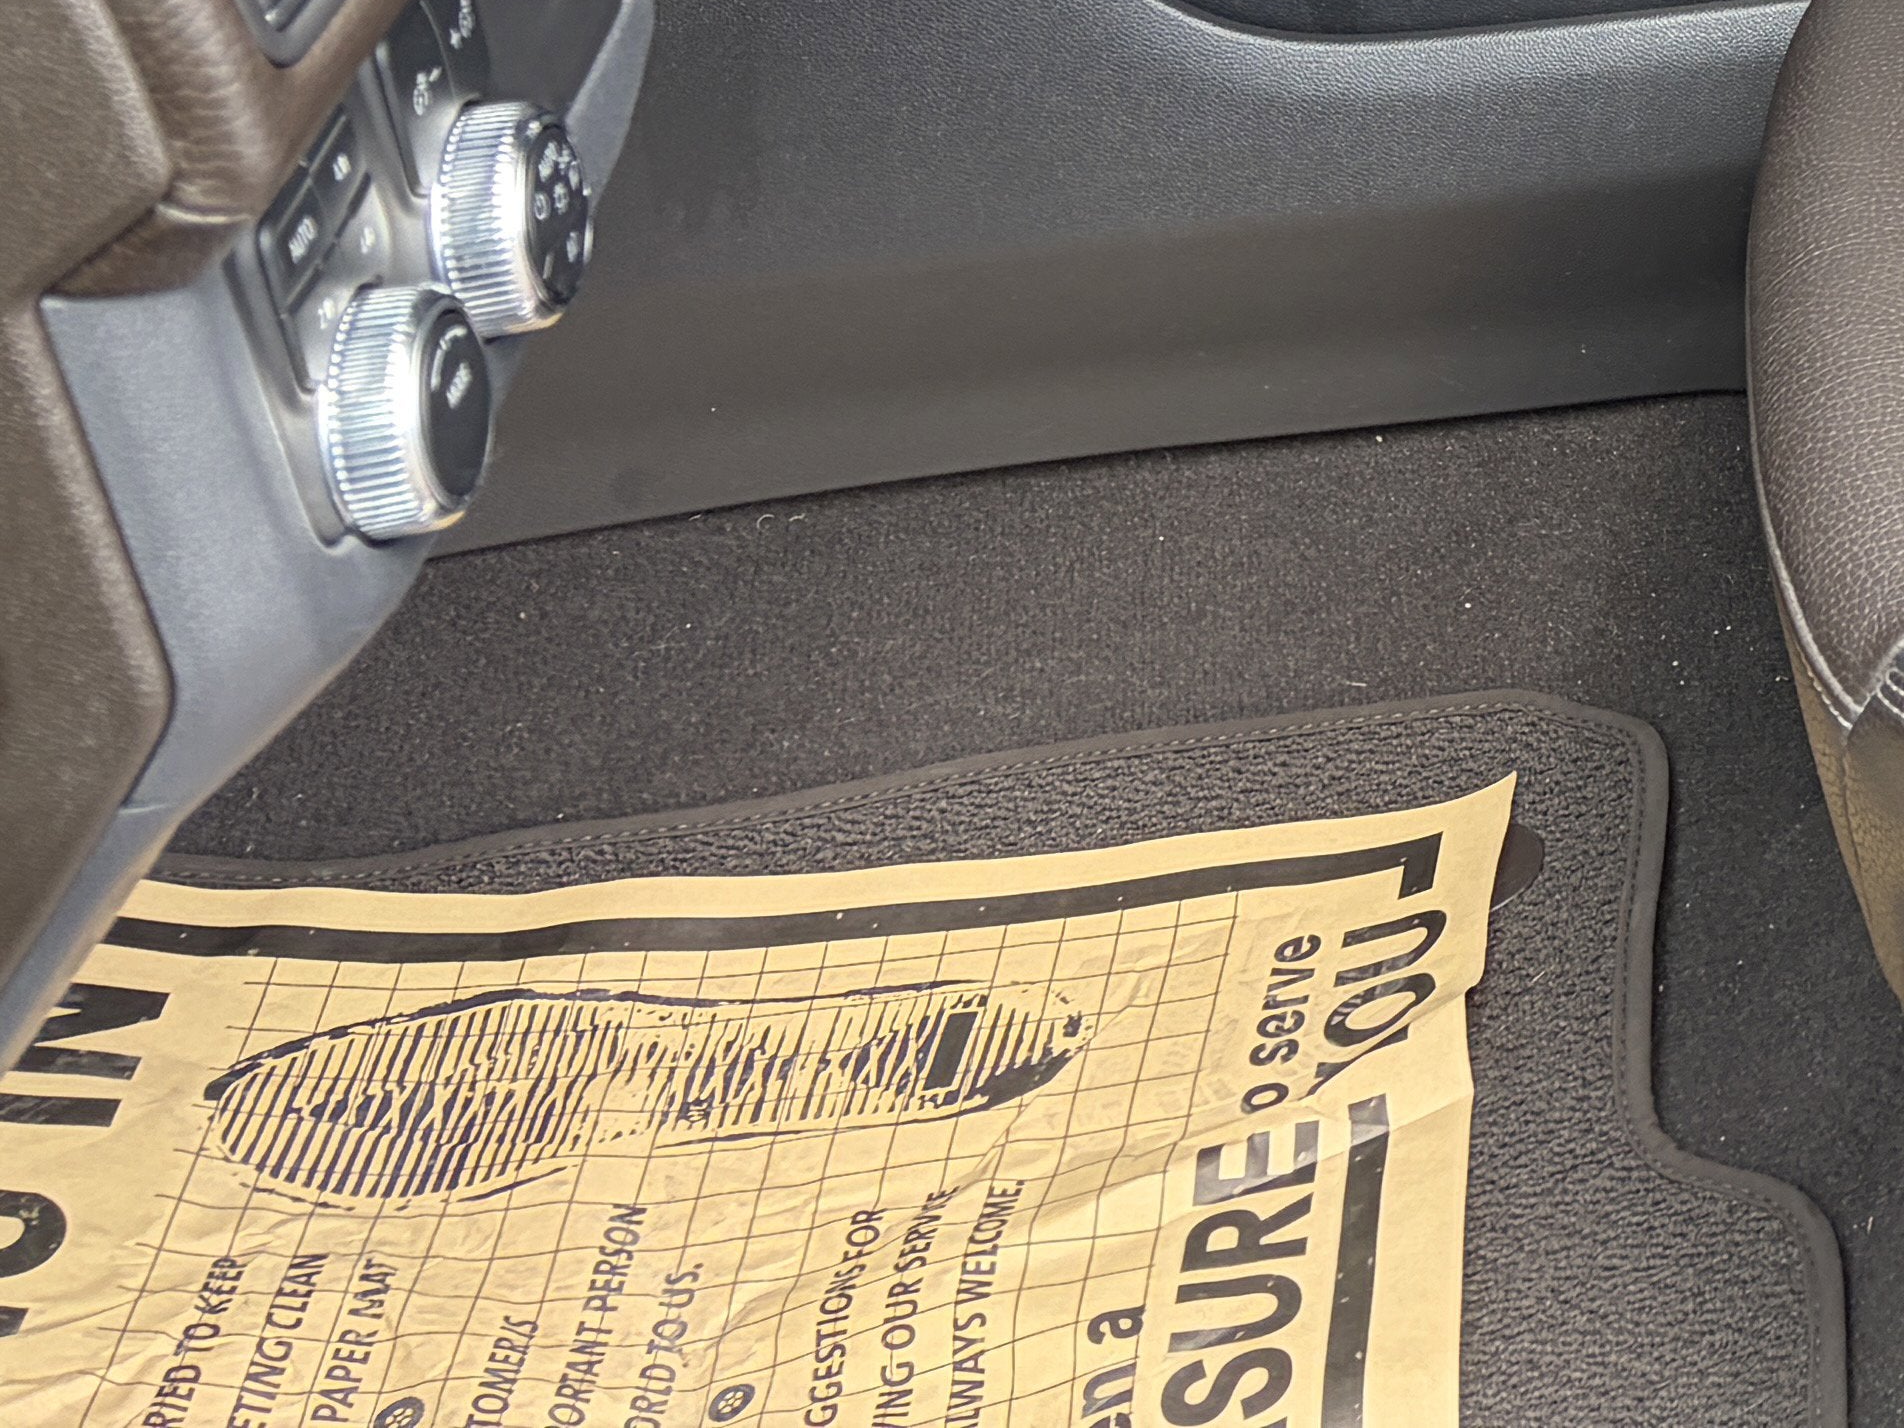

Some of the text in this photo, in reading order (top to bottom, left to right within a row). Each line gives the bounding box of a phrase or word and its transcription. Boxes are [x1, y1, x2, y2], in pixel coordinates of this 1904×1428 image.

[1248, 932, 1322, 1067] serve
[842, 1208, 886, 1265] FOR
[1161, 1119, 1320, 1428] SURE
[194, 1257, 248, 1315] KEEP
[267, 1252, 330, 1329] CLEAN
[544, 1203, 648, 1428] ORTANT PERSON
[881, 1276, 923, 1351] OUR
[943, 1178, 1026, 1428] LWAYS WELCOME.
[1087, 1302, 1145, 1345] a
[173, 1322, 221, 1356] TO
[310, 1257, 399, 1422] PAPER MAT
[645, 1317, 688, 1355] TO
